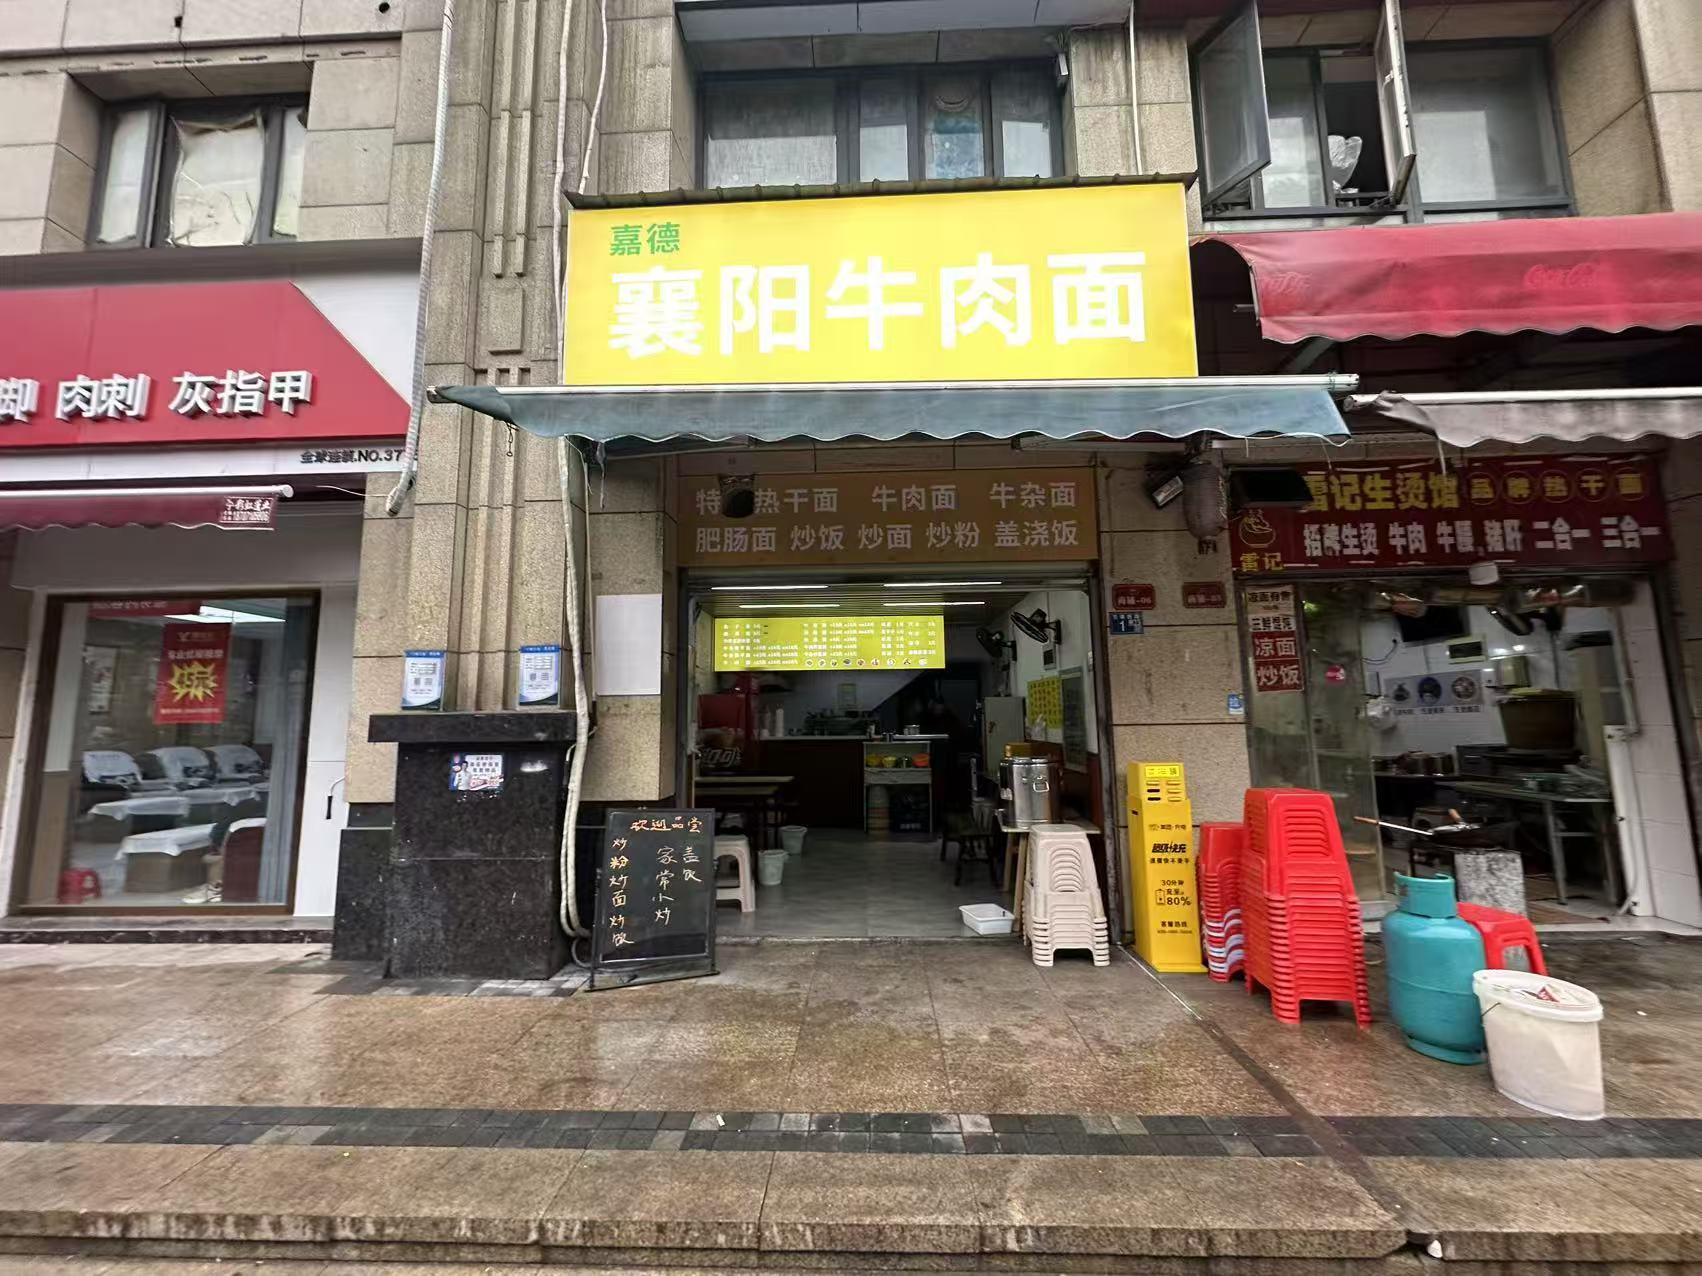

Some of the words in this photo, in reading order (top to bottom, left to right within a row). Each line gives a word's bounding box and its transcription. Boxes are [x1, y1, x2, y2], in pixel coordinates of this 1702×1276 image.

[609, 222, 680, 257] 嘉德
[607, 252, 1147, 360] 襄阳牛肉面
[55, 372, 151, 423] 肉刺
[168, 369, 313, 419] 灰指甲
[696, 487, 839, 515] 特热干面
[871, 484, 957, 512] 牛肉面
[989, 481, 1077, 509] 牛杂面
[696, 527, 776, 553] 肥肠面
[791, 524, 845, 551] 炒饭
[858, 523, 912, 550] 炒面
[926, 521, 980, 549] 炒粉
[994, 520, 1079, 548] 盖浇饭
[1388, 521, 1427, 554] 牛肉
[1532, 517, 1590, 551] 二合一
[1600, 515, 1660, 550] 三合一
[1255, 638, 1296, 658] 凉面
[1257, 664, 1300, 687] 炒饭
[652, 846, 678, 926] 家常小炒
[1166, 896, 1192, 906] 80%
